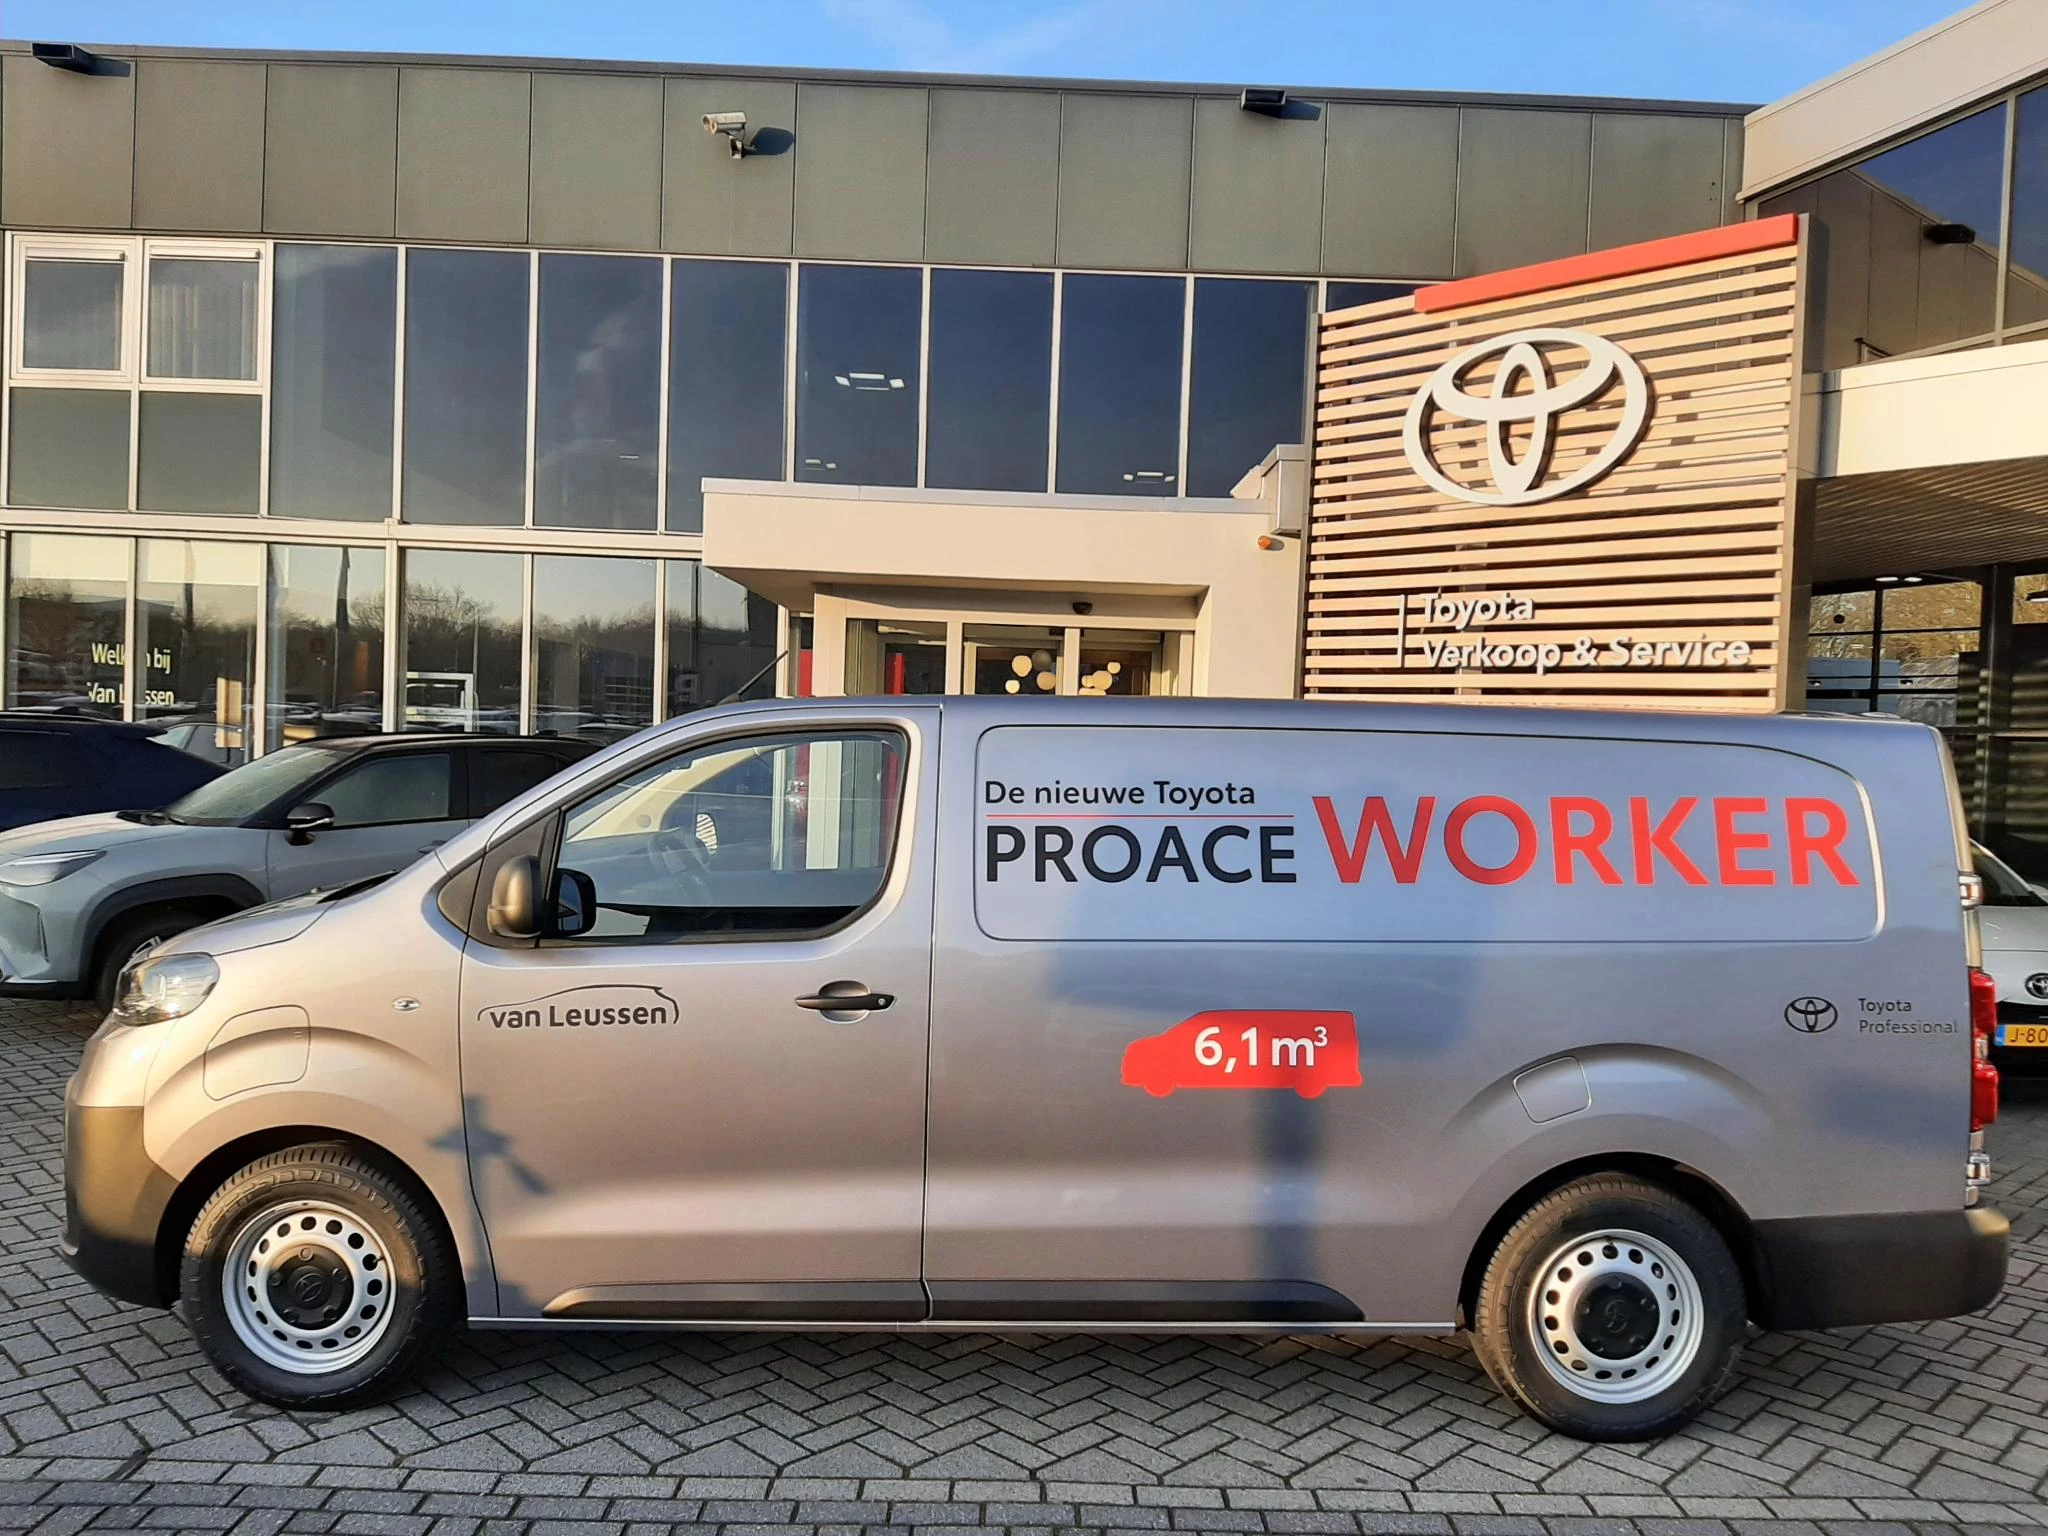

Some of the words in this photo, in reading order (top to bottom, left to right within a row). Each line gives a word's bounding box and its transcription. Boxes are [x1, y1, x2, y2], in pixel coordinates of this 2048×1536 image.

[1421, 592, 1535, 630] Toyota
[153, 647, 172, 674] bij
[1423, 636, 1562, 675] Verkoop
[1572, 635, 1600, 667] &
[1609, 634, 1752, 667] Service
[86, 682, 116, 704] Van
[985, 780, 1026, 805] De
[1034, 780, 1145, 805] nieuwe
[1153, 780, 1256, 812] Toyota
[985, 824, 1298, 884] PROACE
[1311, 795, 1861, 887] WORKER
[489, 1009, 541, 1029] van
[549, 1005, 667, 1027] Leussen
[1857, 998, 1912, 1015] Toyota
[1858, 1019, 1959, 1035] Professional
[1194, 1026, 1258, 1073] 6,1
